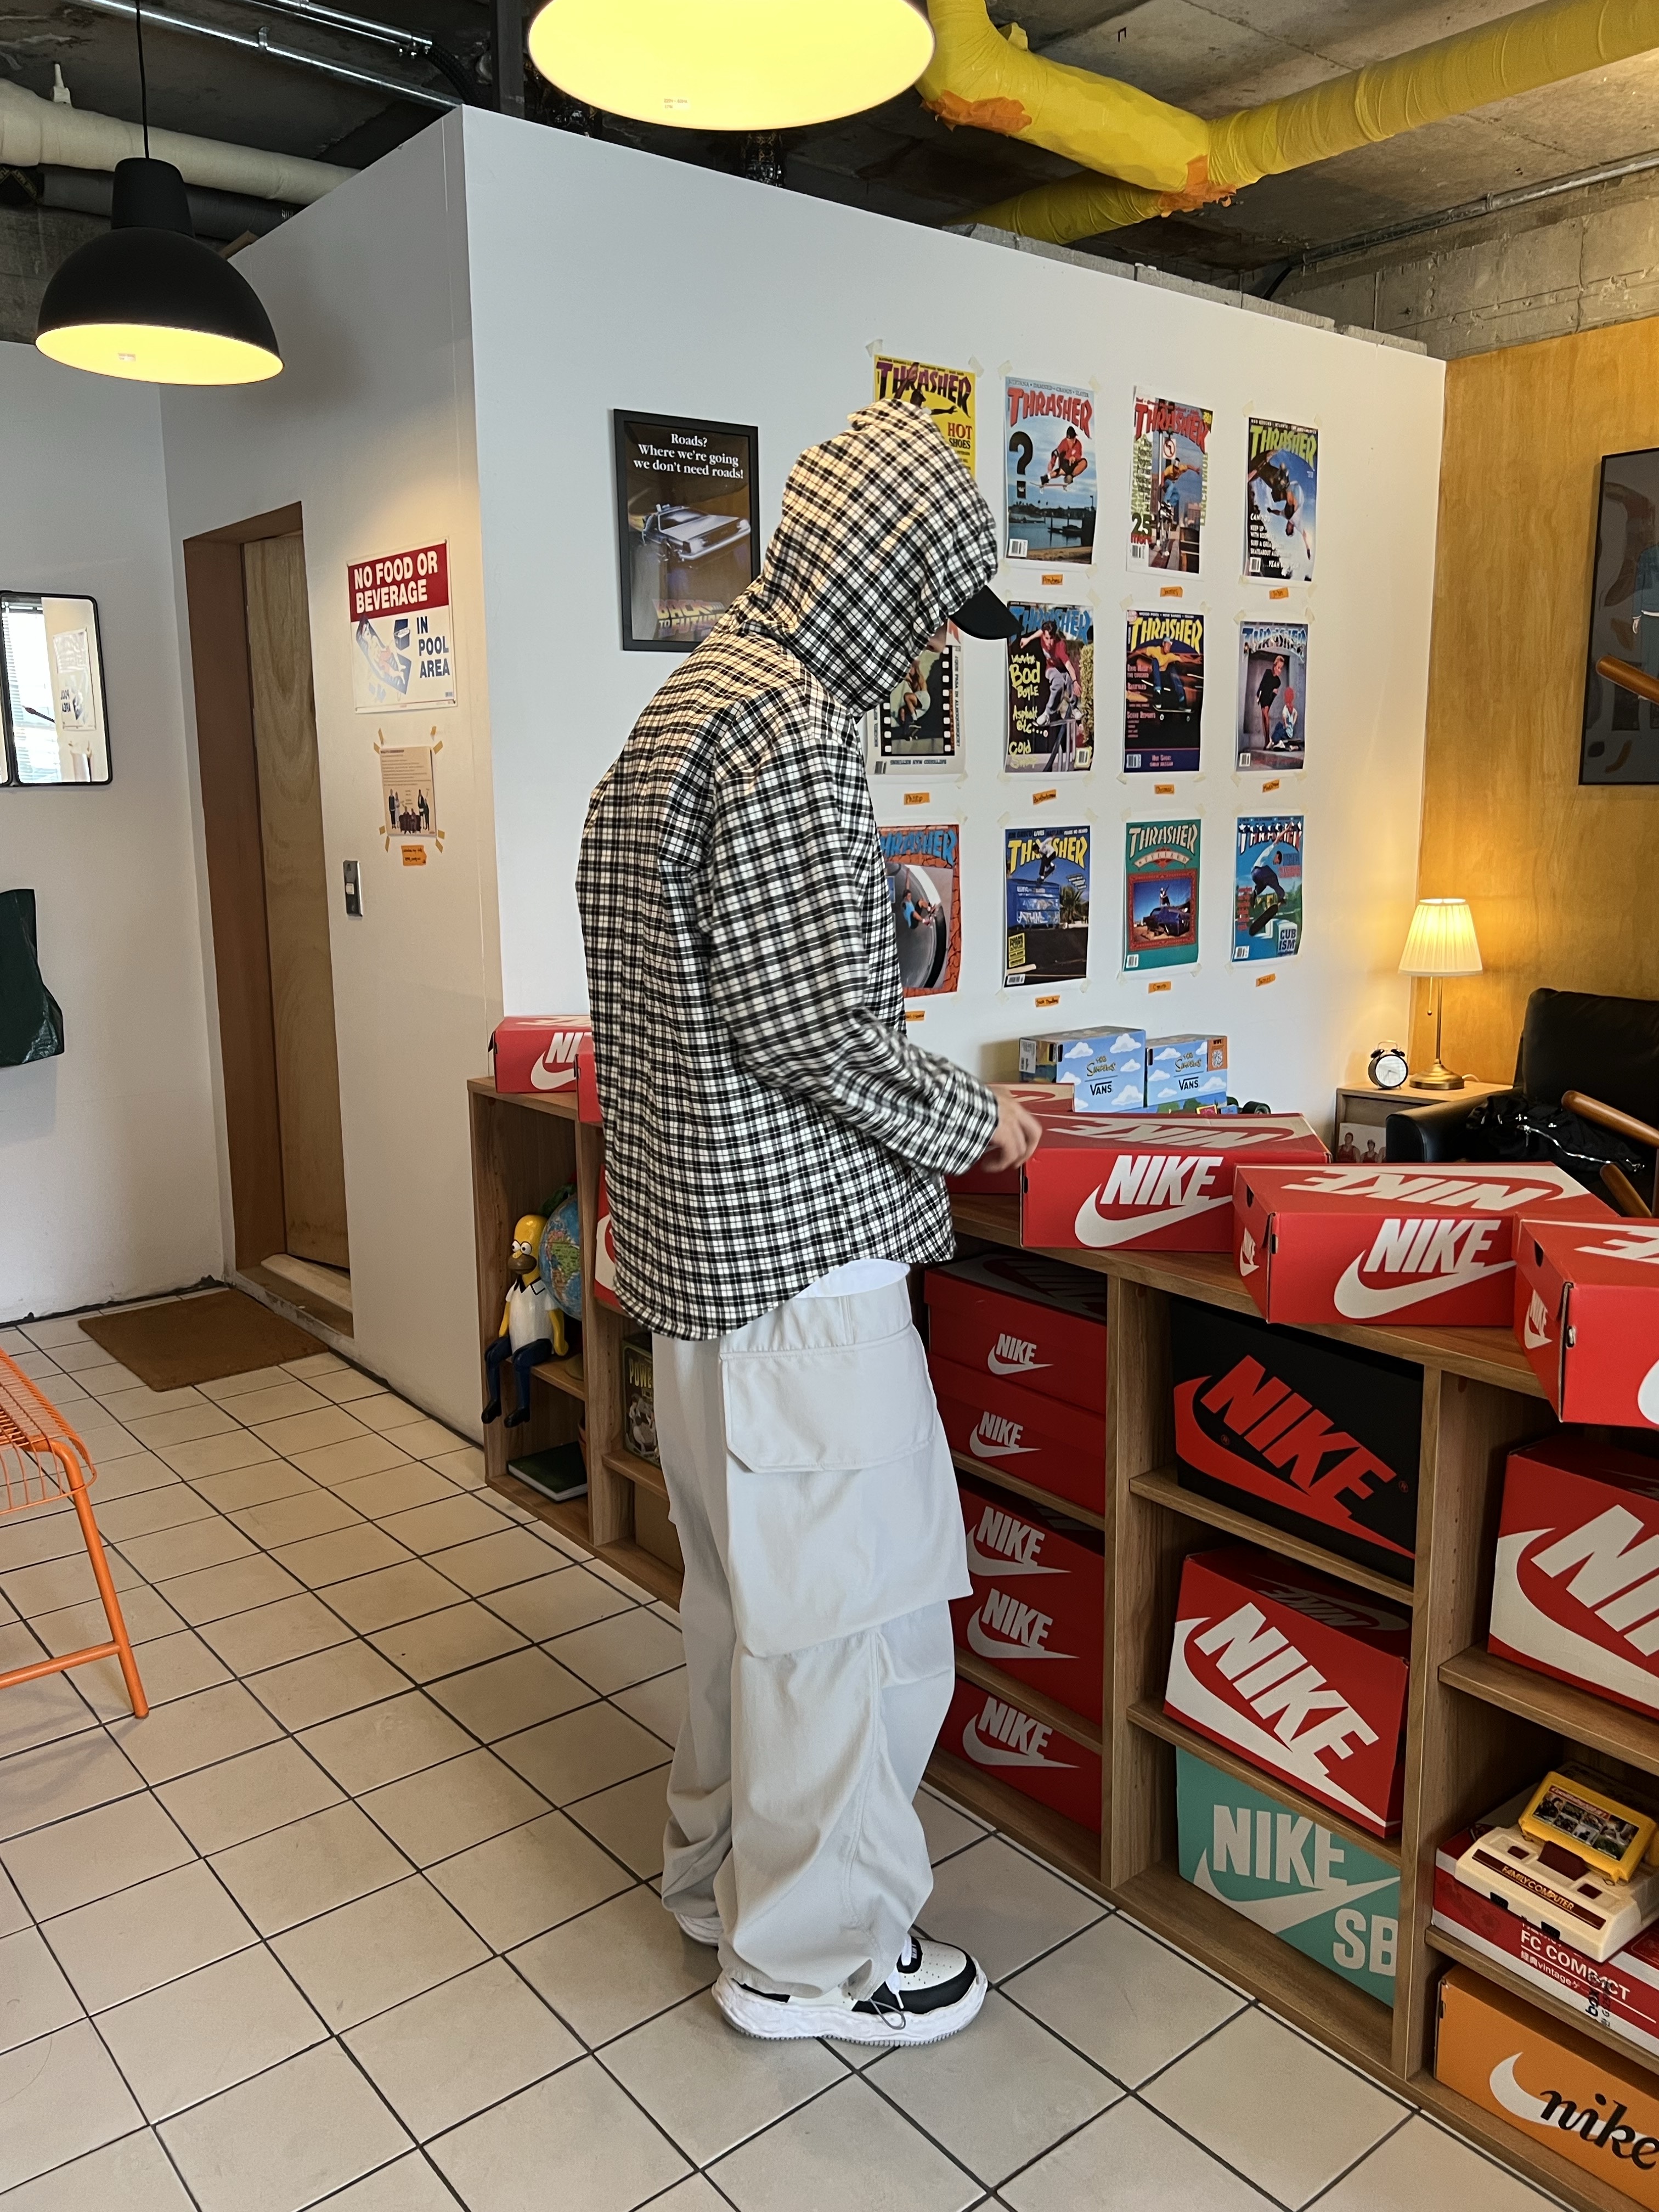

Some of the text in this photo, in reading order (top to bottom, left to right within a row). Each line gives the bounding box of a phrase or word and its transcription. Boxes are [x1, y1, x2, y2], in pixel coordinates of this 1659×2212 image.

[947, 422, 973, 440] HOT
[1007, 387, 1092, 439] THRASHER
[1135, 403, 1209, 455] THRASHER
[638, 443, 739, 467] Where we're going
[671, 433, 708, 447] Roads?
[949, 437, 970, 449] SHOES
[1250, 425, 1317, 472] THRASHER
[633, 459, 744, 479] we don't need roads!
[1131, 512, 1153, 535] 25
[354, 550, 438, 590] NO FOOD OR
[355, 579, 428, 614] BEVERAGE
[652, 599, 712, 619] BACK
[416, 616, 429, 634] IN
[659, 619, 671, 628] TO
[1130, 617, 1203, 656] THRASHER
[418, 635, 449, 657] POOL
[420, 658, 450, 679] AREA
[880, 828, 957, 867] HRASHER
[1008, 836, 1088, 874] THRSHER
[1128, 823, 1198, 859] THRASHER
[1278, 939, 1296, 951] ISM
[1280, 928, 1296, 940] CUB
[545, 1032, 592, 1064] NI
[1090, 1081, 1113, 1096] VANS
[1178, 1076, 1199, 1091] VANS
[1099, 1155, 1224, 1206] NIKE
[1280, 1170, 1553, 1211] NIKE
[1362, 1218, 1502, 1274] NIKE
[996, 1333, 1037, 1365] NIKE
[629, 1358, 652, 1389] POWE
[978, 1411, 1024, 1449] NIKE
[1200, 1355, 1397, 1518] NIKE
[975, 1506, 1045, 1566] NIKE
[1530, 1504, 1659, 1657] NI
[981, 1588, 1053, 1650] NIKE
[1194, 1602, 1379, 1776] NIKE
[977, 1696, 1053, 1759] NIKE
[1213, 1804, 1347, 1889] NIKE
[1333, 1908, 1398, 1976] SB
[1521, 1929, 1542, 1951] FC
[1539, 2091, 1659, 2170] nike
